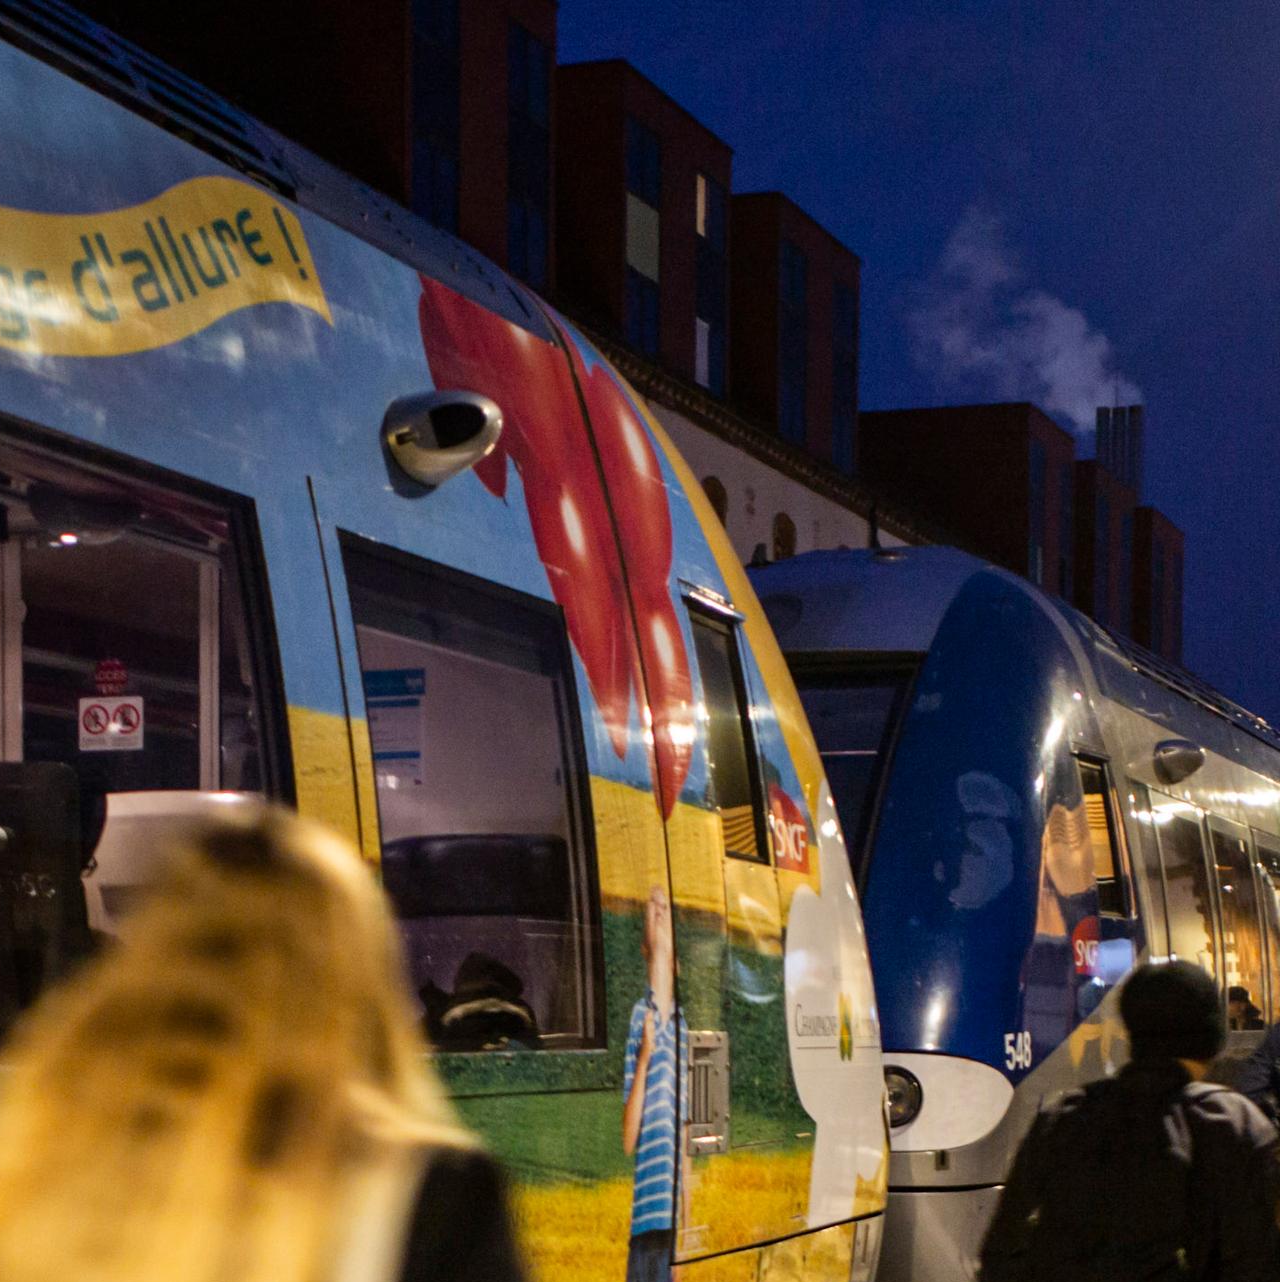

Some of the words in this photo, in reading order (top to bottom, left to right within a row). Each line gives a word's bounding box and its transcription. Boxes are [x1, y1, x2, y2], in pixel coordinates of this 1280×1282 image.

[71, 208, 273, 322] d'allure
[775, 817, 806, 863] SNCF
[1004, 1030, 1032, 1071] 548
